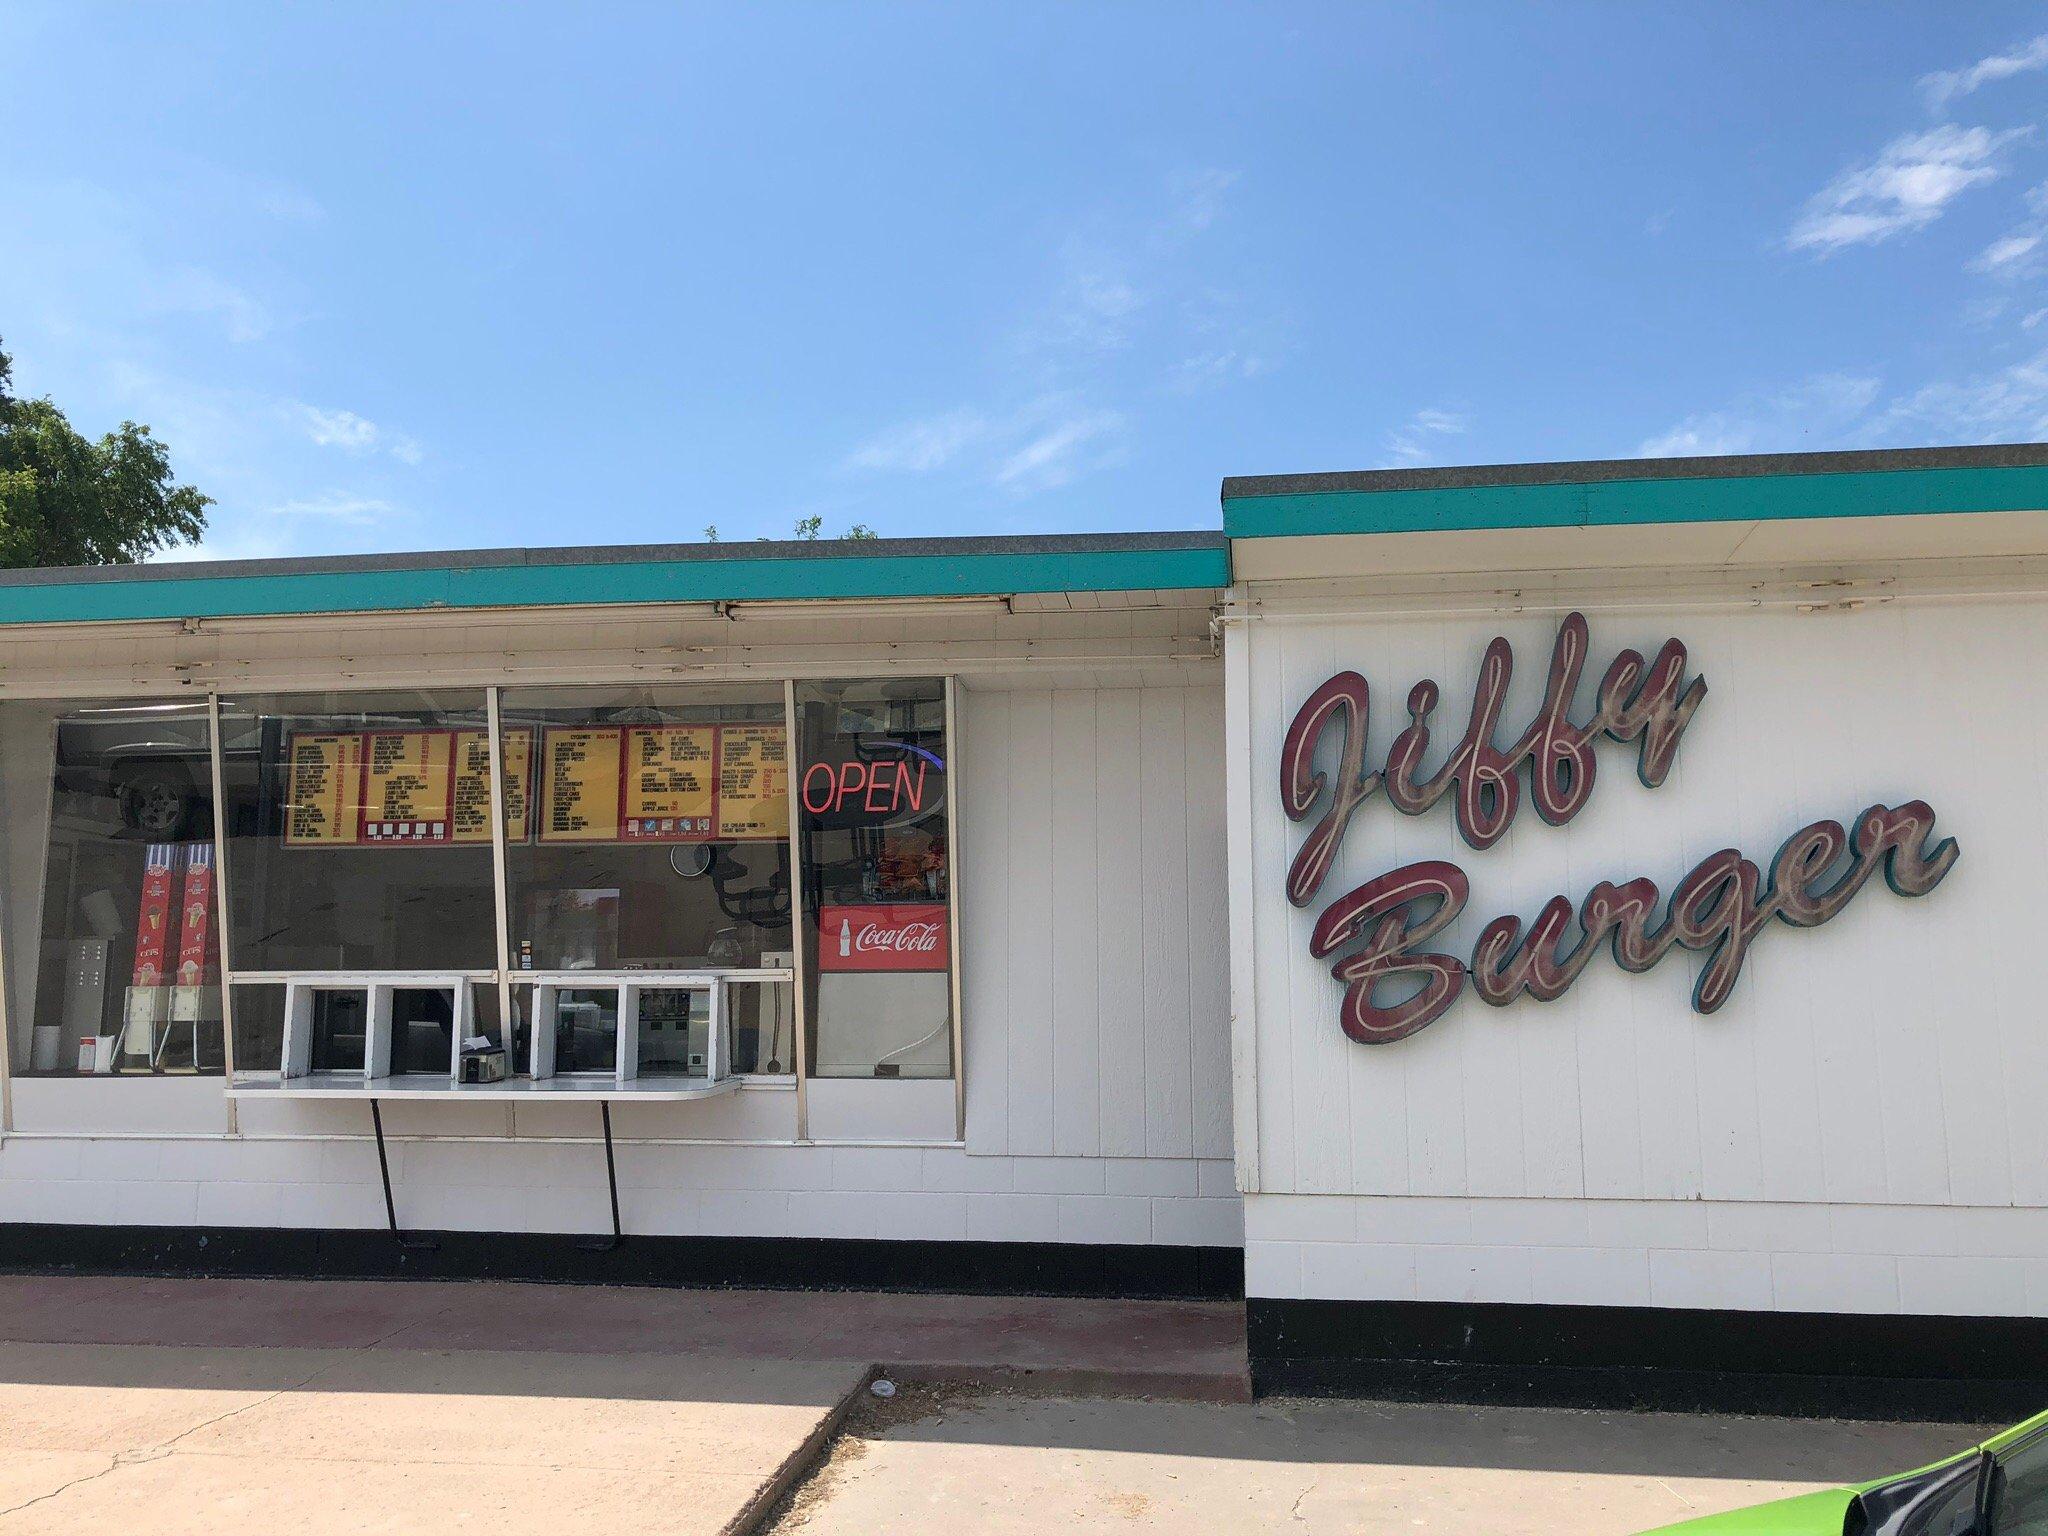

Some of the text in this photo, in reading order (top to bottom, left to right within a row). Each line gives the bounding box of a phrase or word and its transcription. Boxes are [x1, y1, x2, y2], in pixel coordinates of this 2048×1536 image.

[802, 760, 926, 814] OPEN
[1280, 611, 1708, 908] Jiffy
[1310, 800, 1960, 1045] Burger
